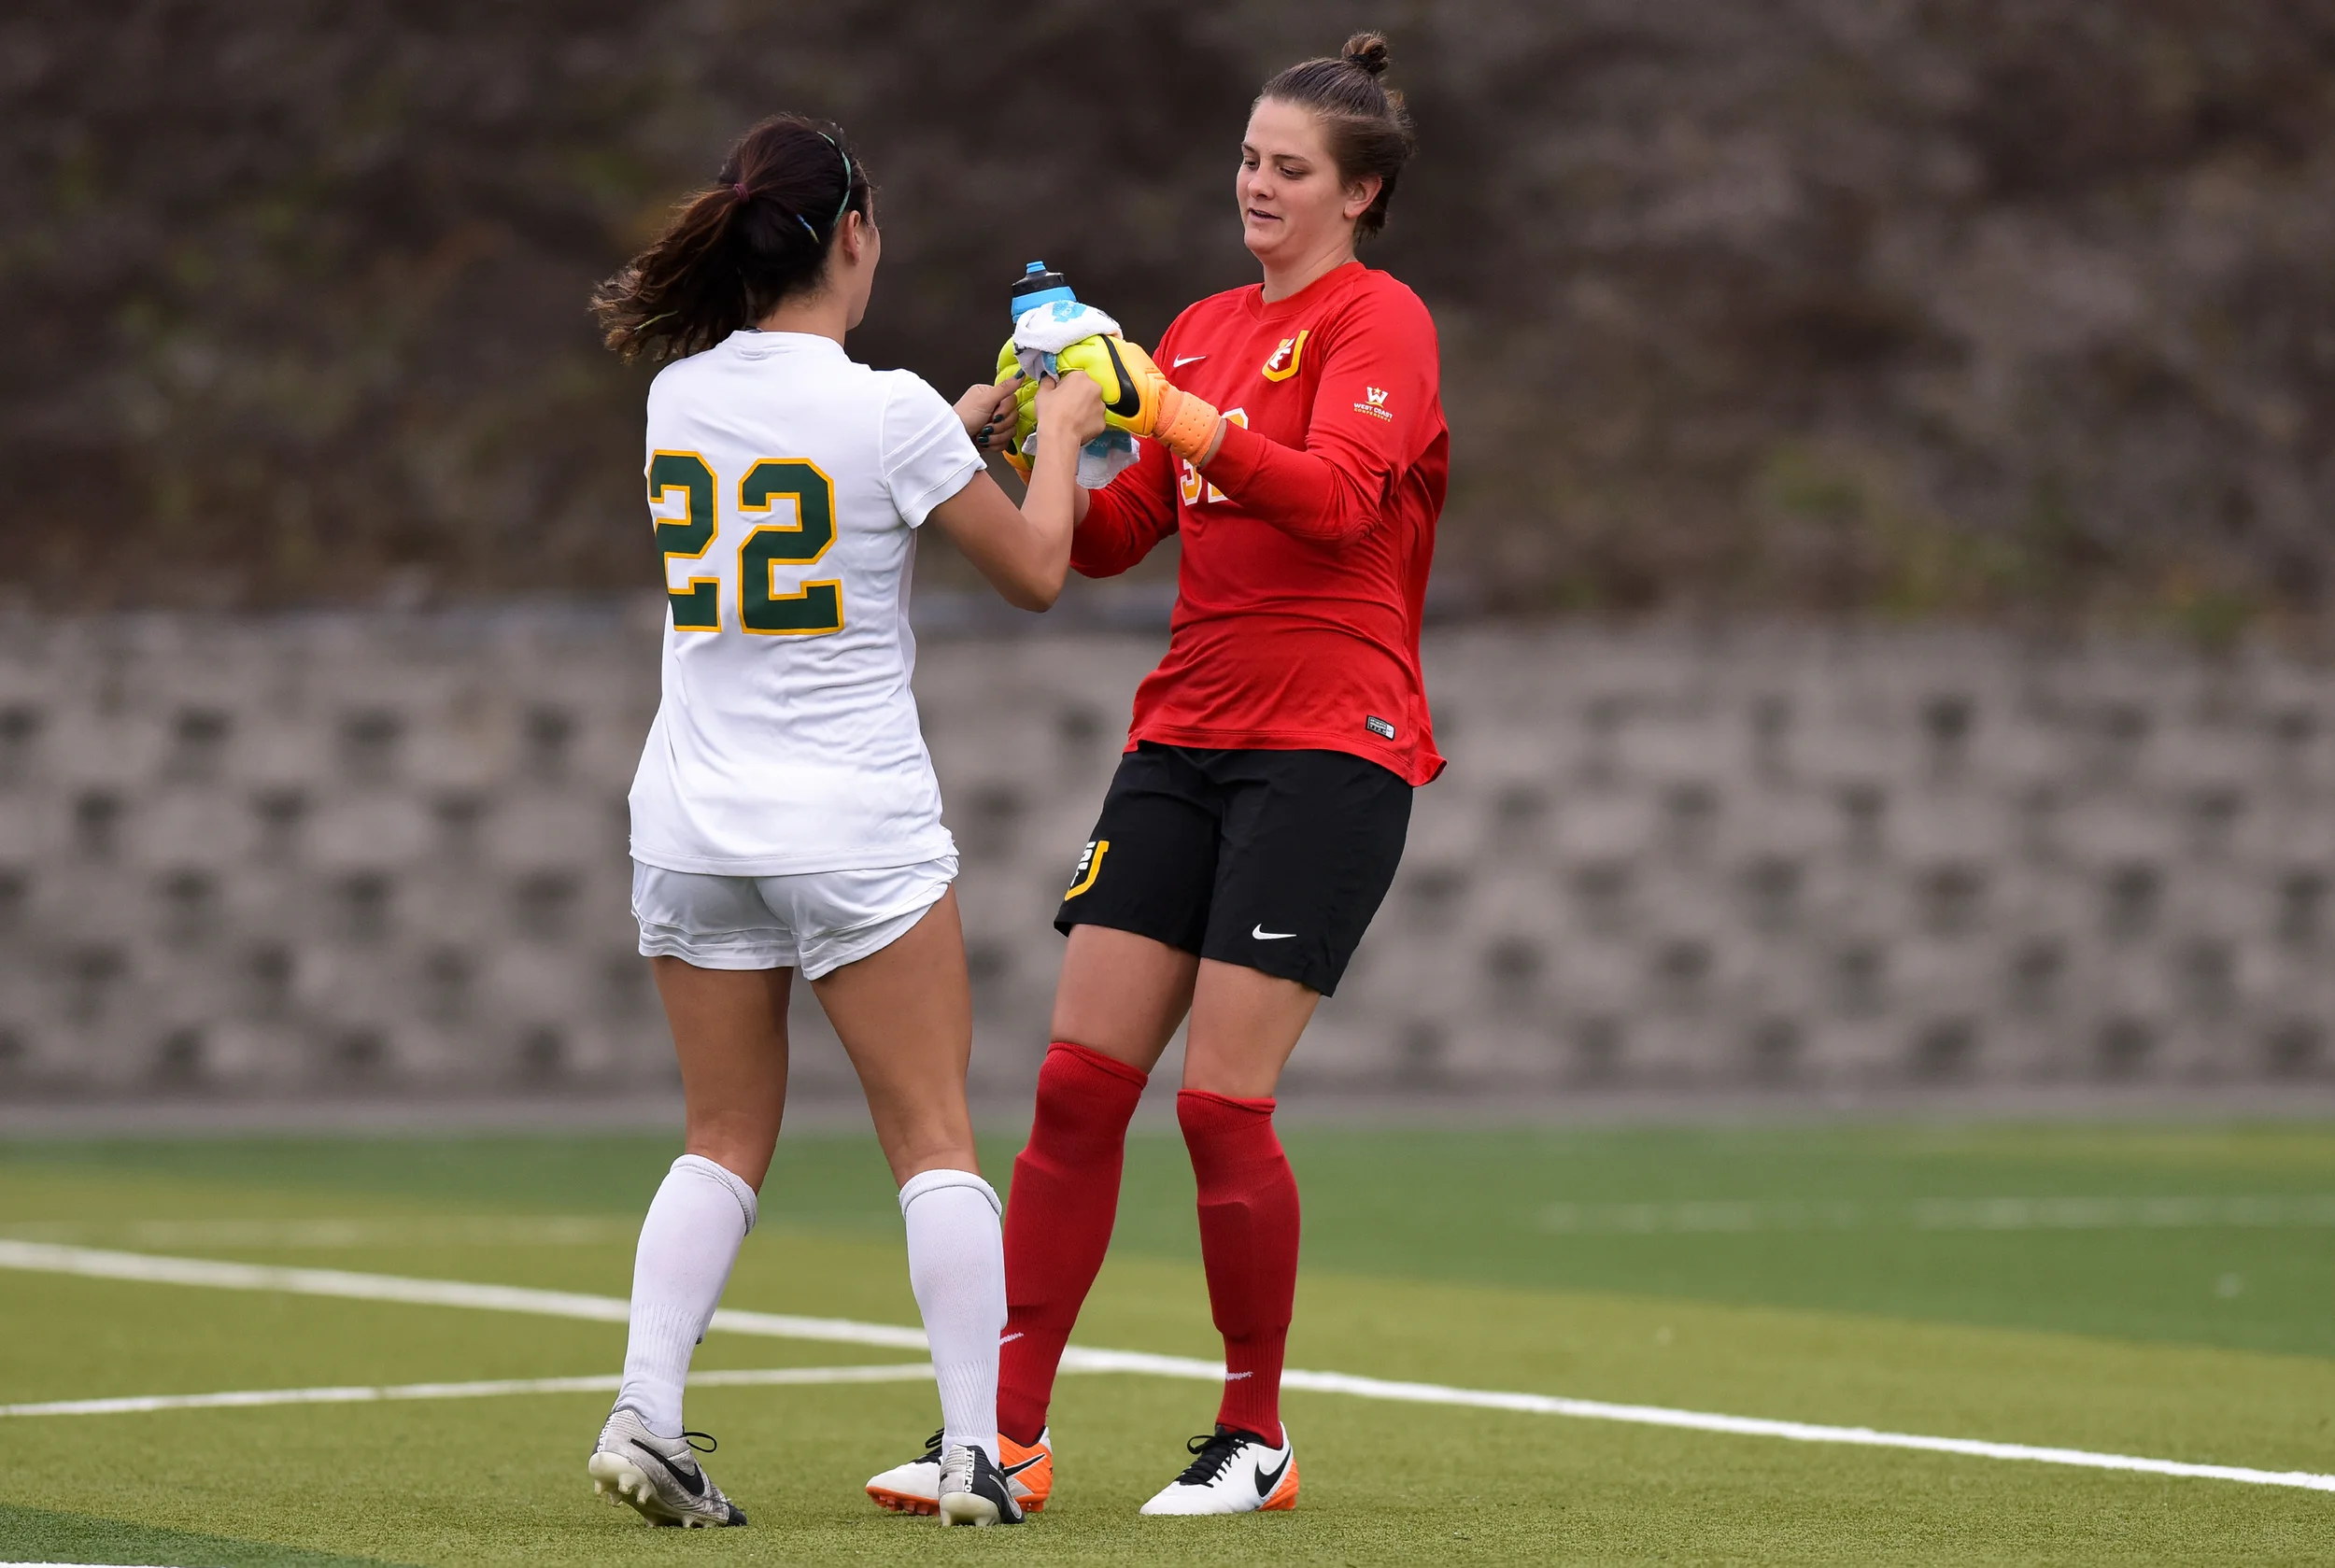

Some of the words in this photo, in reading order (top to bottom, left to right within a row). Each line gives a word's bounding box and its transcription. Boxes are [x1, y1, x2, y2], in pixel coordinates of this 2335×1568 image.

[1353, 403, 1373, 412] WEST
[1373, 407, 1393, 419] COAST
[648, 449, 844, 636] 22
[964, 1449, 975, 1492] TIEMPO
